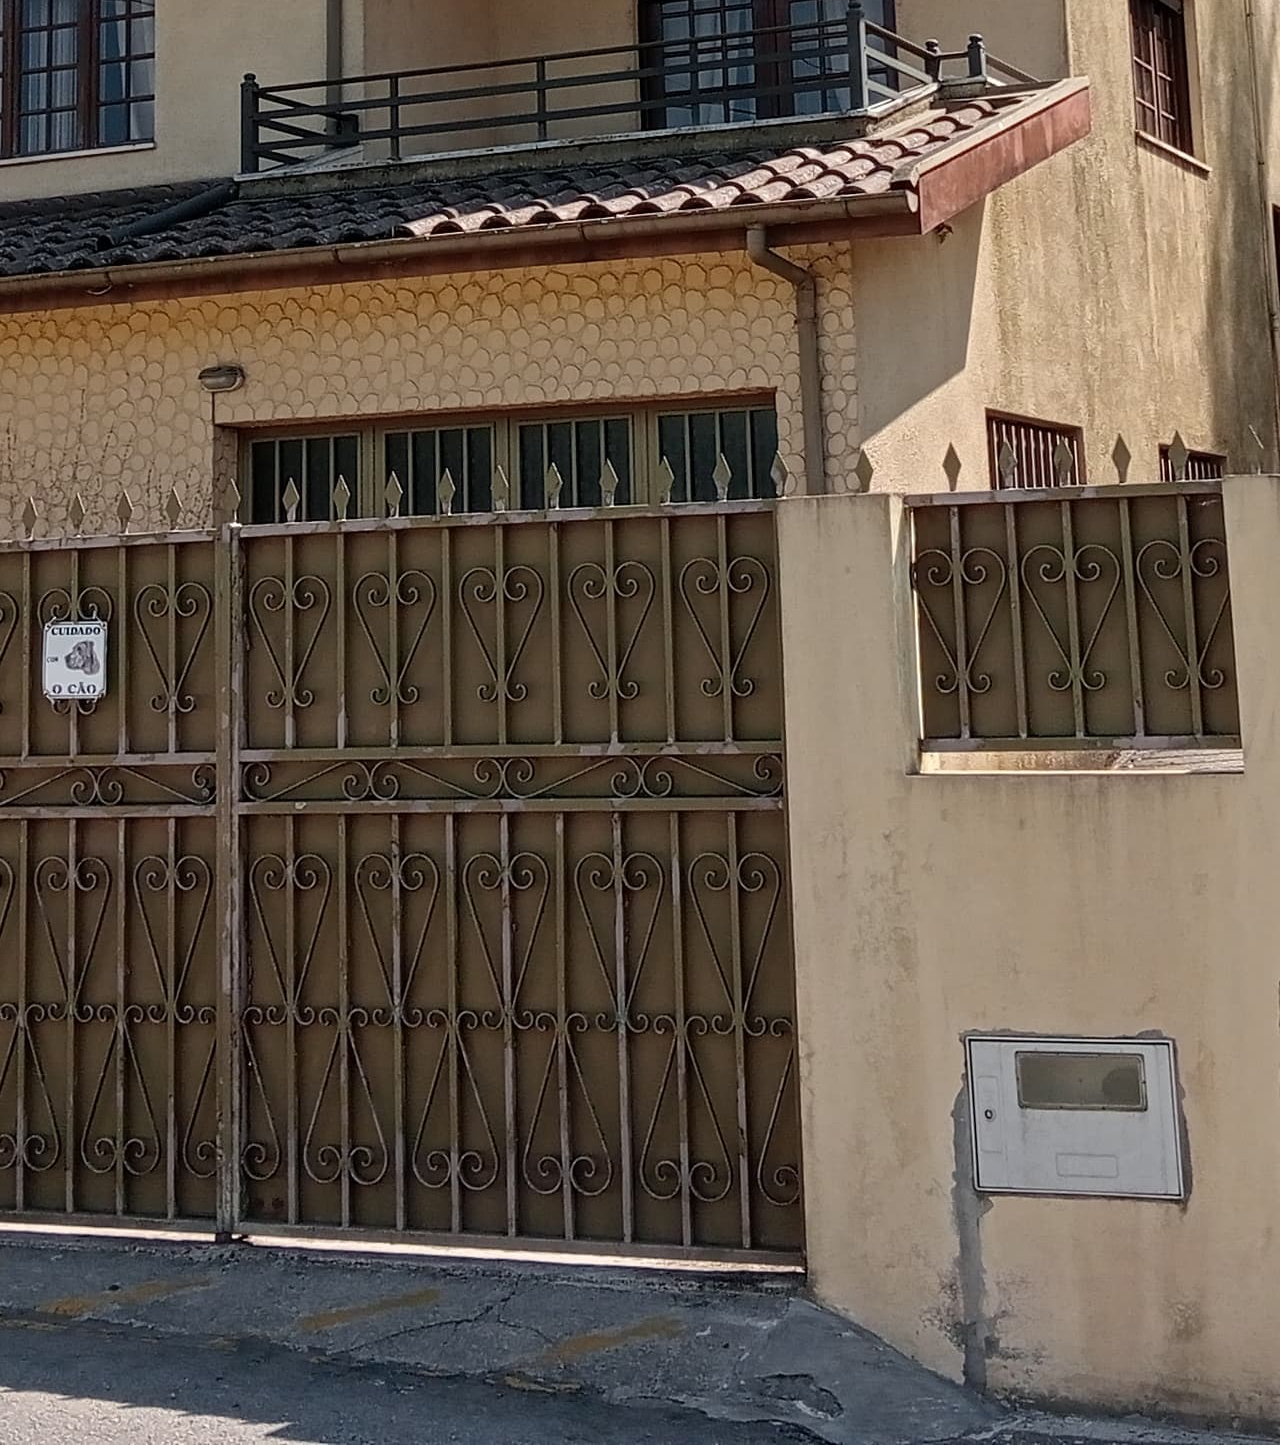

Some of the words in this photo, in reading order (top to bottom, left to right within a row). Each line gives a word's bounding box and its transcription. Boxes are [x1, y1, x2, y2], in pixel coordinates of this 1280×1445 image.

[51, 626, 101, 636] CUIDADO
[52, 684, 62, 694] O
[67, 681, 97, 694] CÃO
